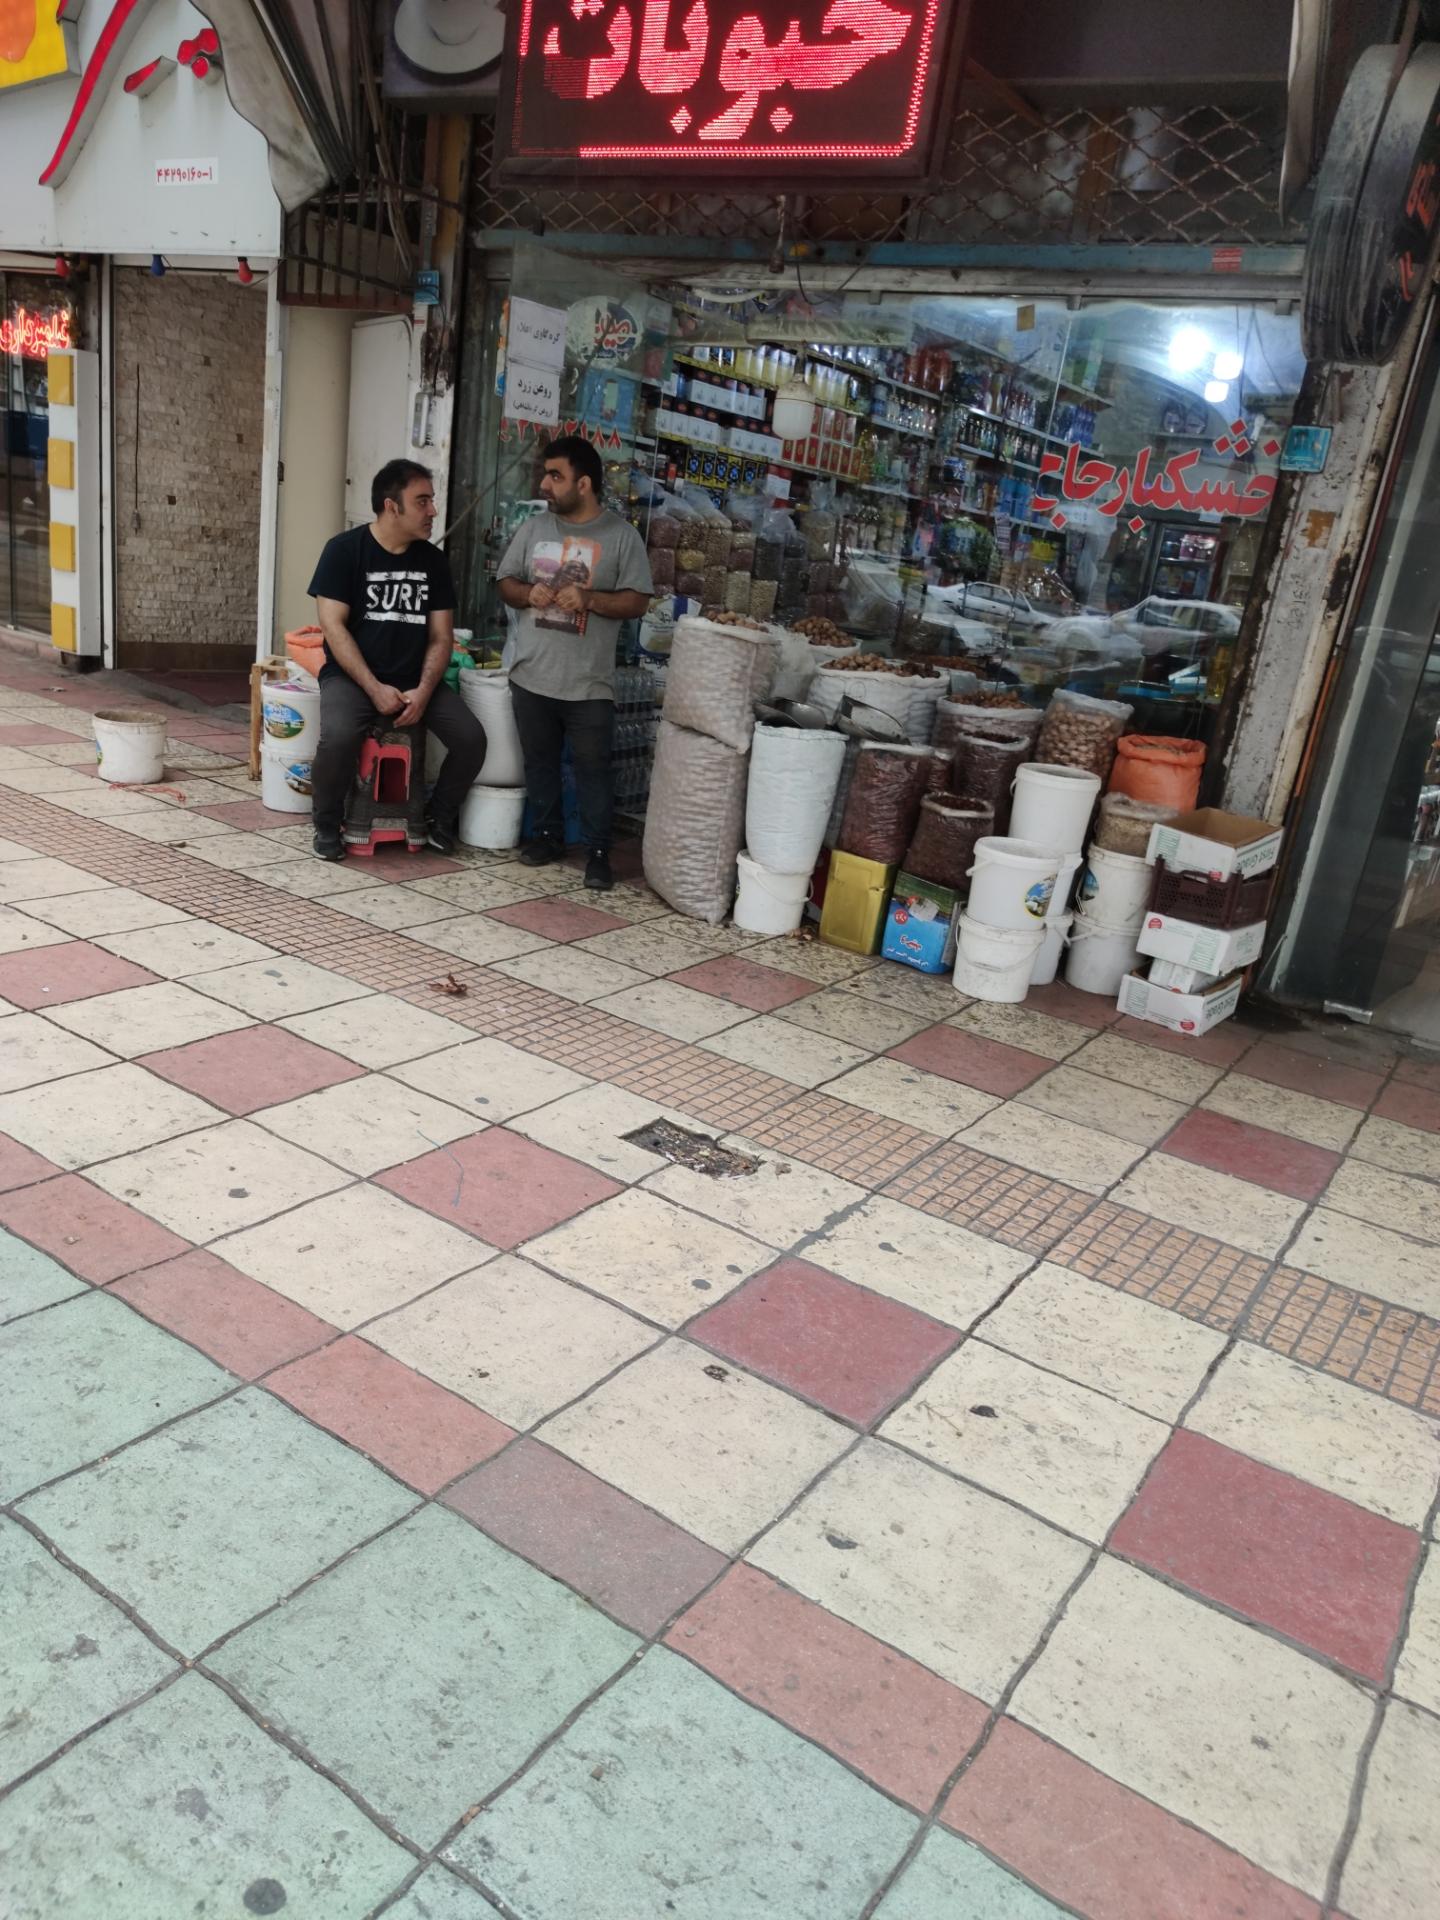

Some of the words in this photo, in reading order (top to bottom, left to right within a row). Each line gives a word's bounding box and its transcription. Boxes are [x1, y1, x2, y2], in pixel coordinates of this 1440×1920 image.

[517, 378, 532, 394] زرد
[532, 383, 553, 399] روغن
[1096, 418, 1282, 533] خشکبار
[366, 583, 429, 611] SURF
